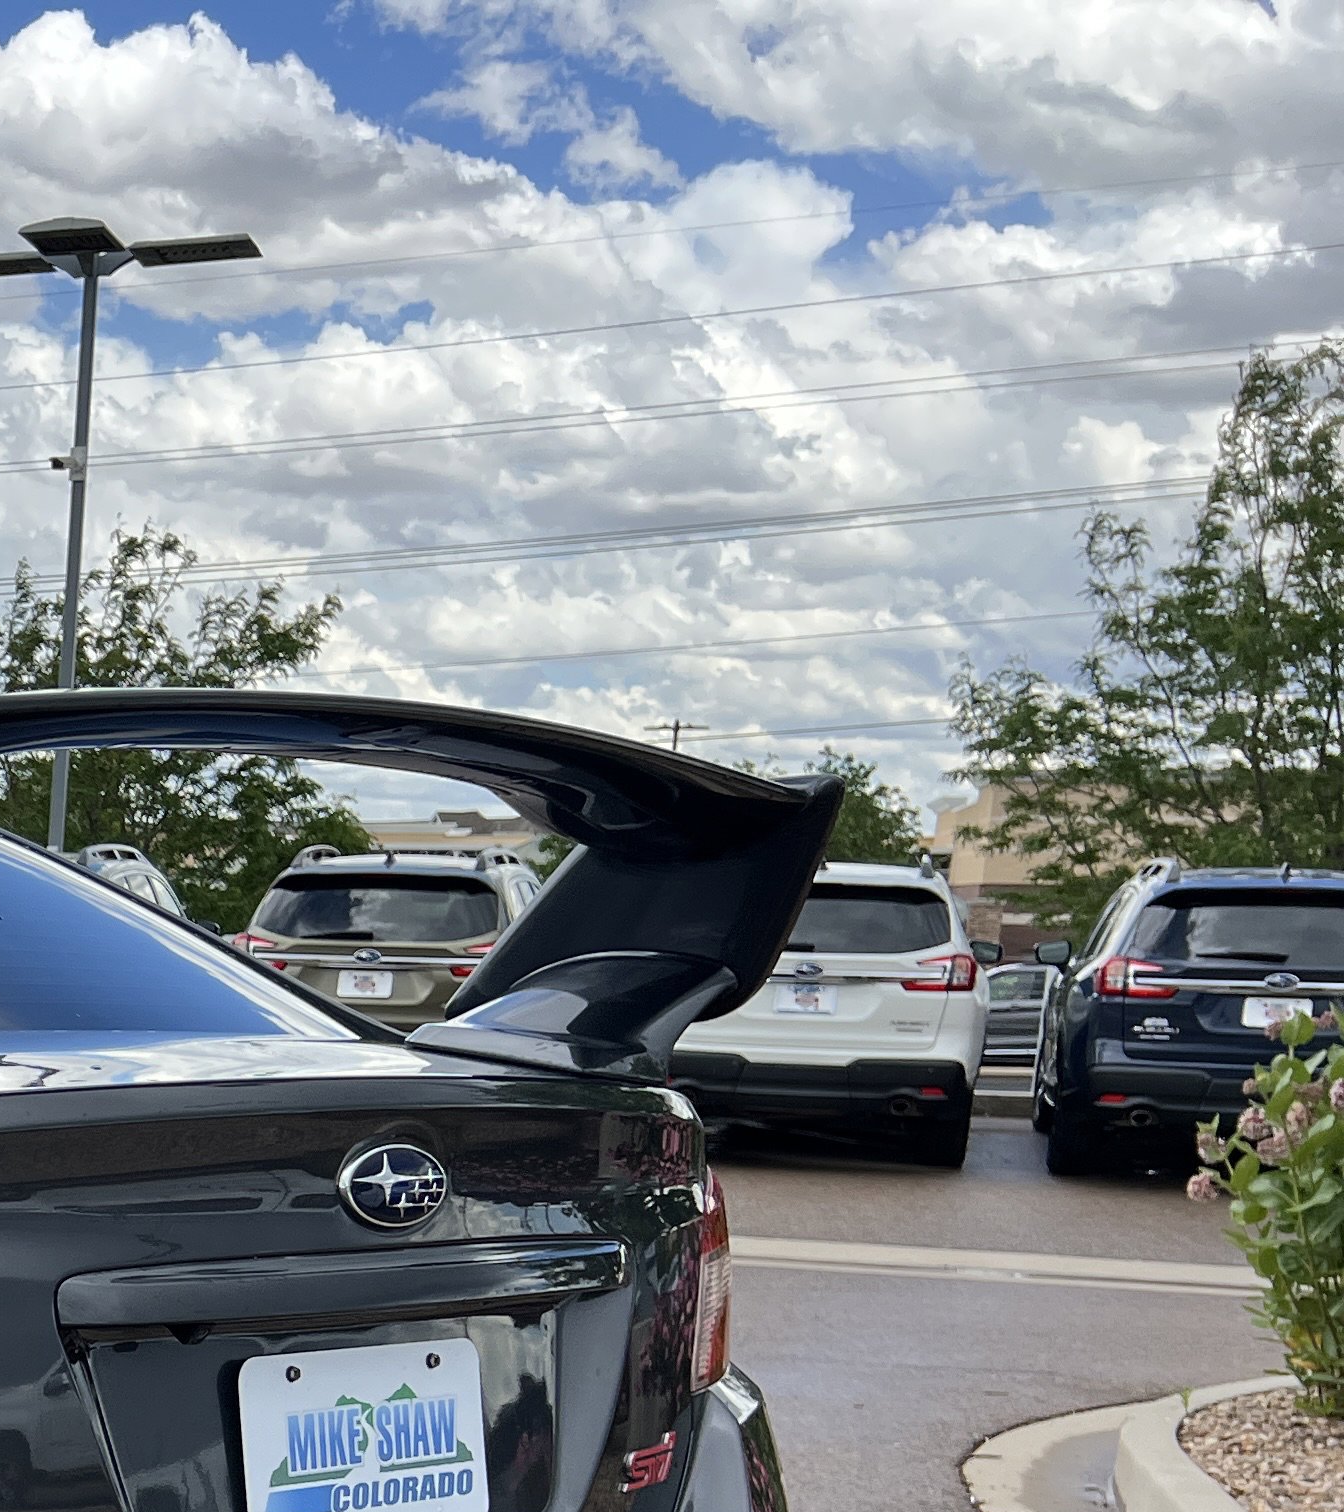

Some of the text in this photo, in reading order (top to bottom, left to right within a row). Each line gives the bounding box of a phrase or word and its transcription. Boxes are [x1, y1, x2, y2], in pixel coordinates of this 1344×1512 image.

[287, 1398, 455, 1472] MIKE SHAW
[332, 1469, 473, 1512] COLORADO
